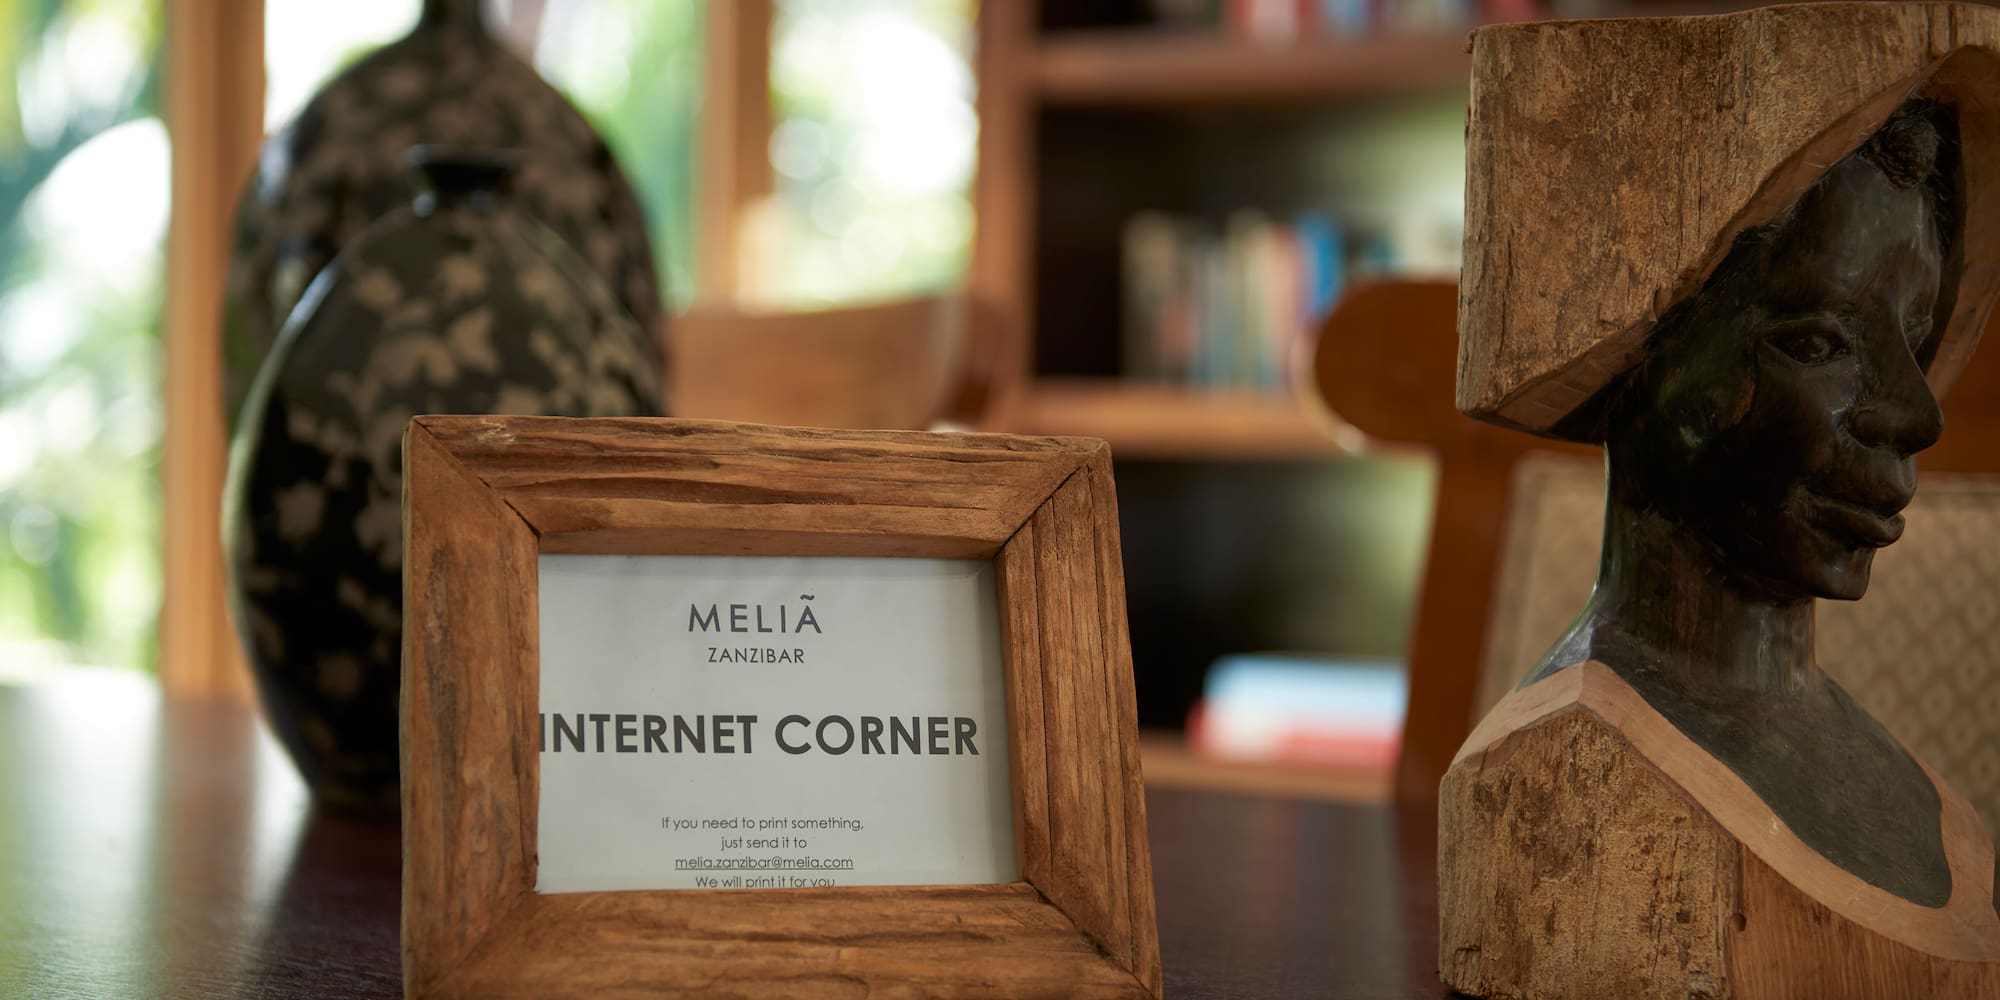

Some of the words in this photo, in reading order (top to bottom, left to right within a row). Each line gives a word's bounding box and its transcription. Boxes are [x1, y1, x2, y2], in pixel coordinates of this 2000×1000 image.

[687, 594, 823, 634] MELIÃ
[707, 647, 805, 665] ZANZIBAR
[539, 713, 758, 754] INTERNET
[774, 714, 980, 756] CORNER
[661, 816, 671, 829] If
[672, 819, 699, 832] you
[702, 817, 738, 830] need
[742, 817, 756, 830] to
[759, 816, 789, 832] print
[791, 816, 865, 833] something,
[720, 836, 744, 851] just
[746, 836, 779, 850] send
[782, 836, 790, 850] it
[793, 836, 808, 850] to
[675, 856, 854, 871] melia.zanzibar@melia.com
[695, 876, 718, 888] We
[721, 876, 742, 888] will
[746, 876, 776, 888] print
[778, 875, 786, 887] it
[789, 875, 807, 887] for
